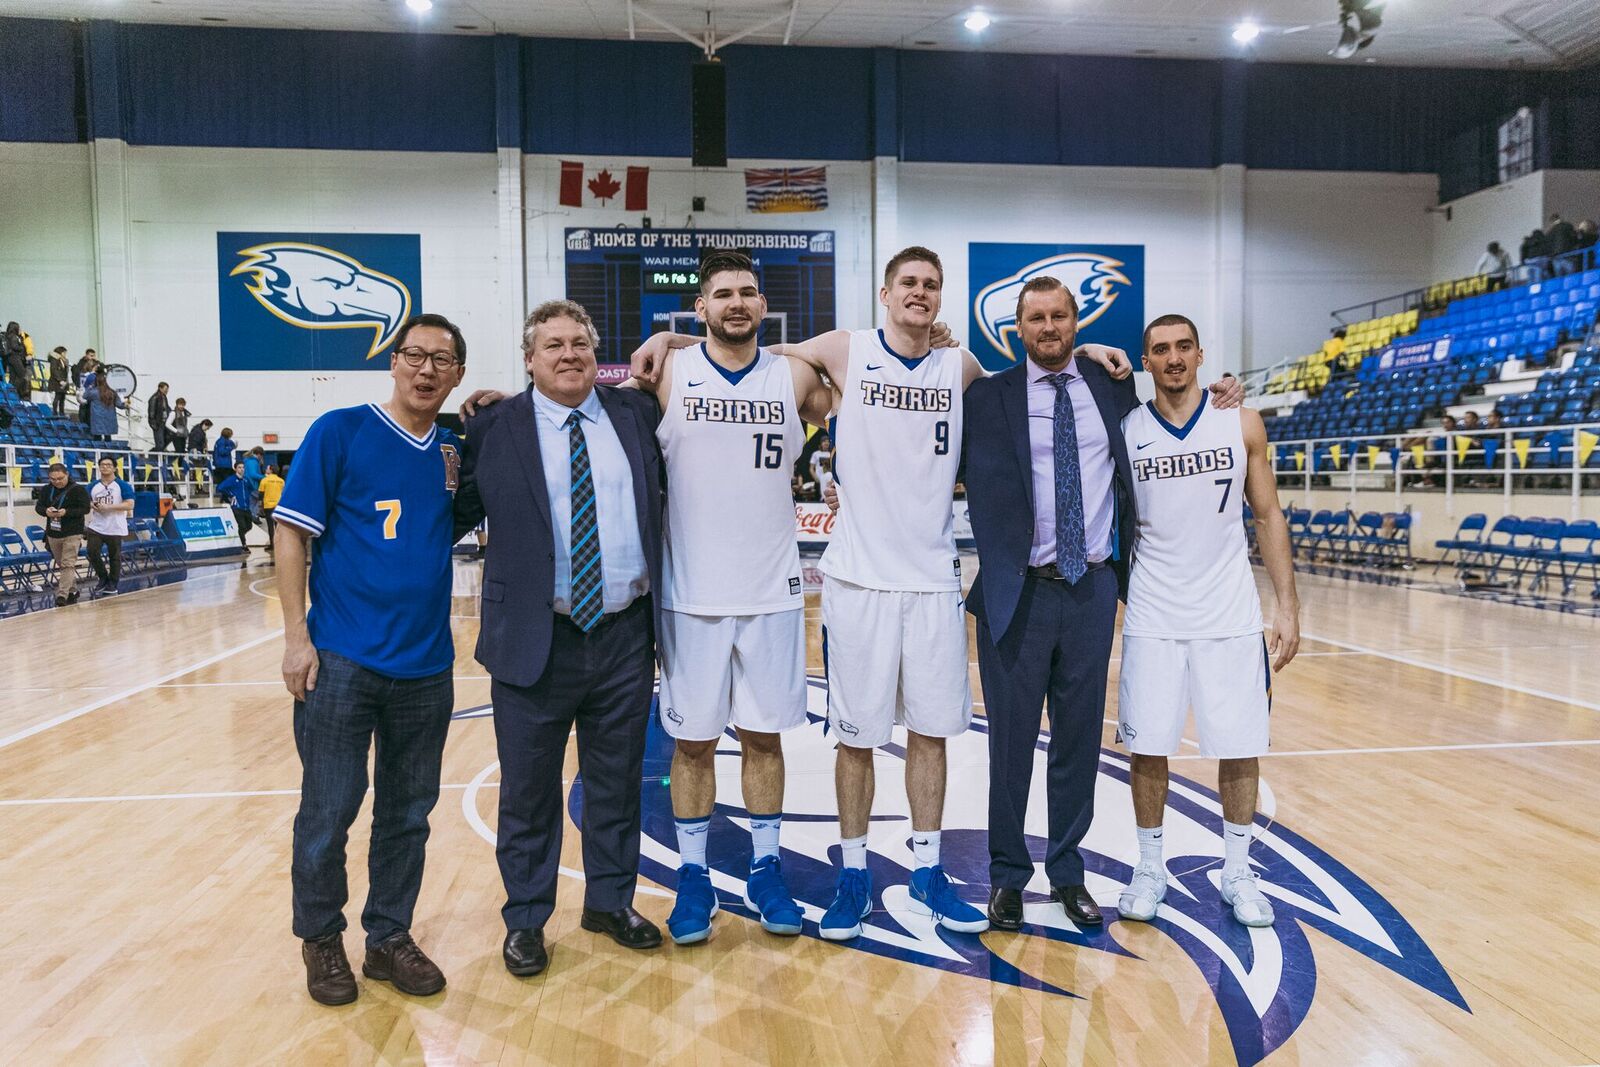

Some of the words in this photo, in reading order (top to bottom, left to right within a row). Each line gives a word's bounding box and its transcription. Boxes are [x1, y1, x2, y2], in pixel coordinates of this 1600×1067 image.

[594, 233, 636, 247] HOME
[641, 233, 659, 247] OF
[662, 234, 691, 248] THE
[695, 234, 808, 248] THUNDERBIRDS
[644, 257, 670, 265] WAR
[672, 257, 699, 265] MEM
[671, 273, 687, 284] Feb
[653, 313, 670, 321] HOM
[595, 369, 626, 378] OAST
[683, 397, 785, 425] T-BIRDS
[861, 380, 951, 412] T-BIRDS
[752, 433, 783, 469] 15
[934, 421, 949, 455] 9
[1133, 447, 1234, 482] T-BIRDS
[1214, 478, 1233, 513] 7
[375, 499, 402, 540] 7
